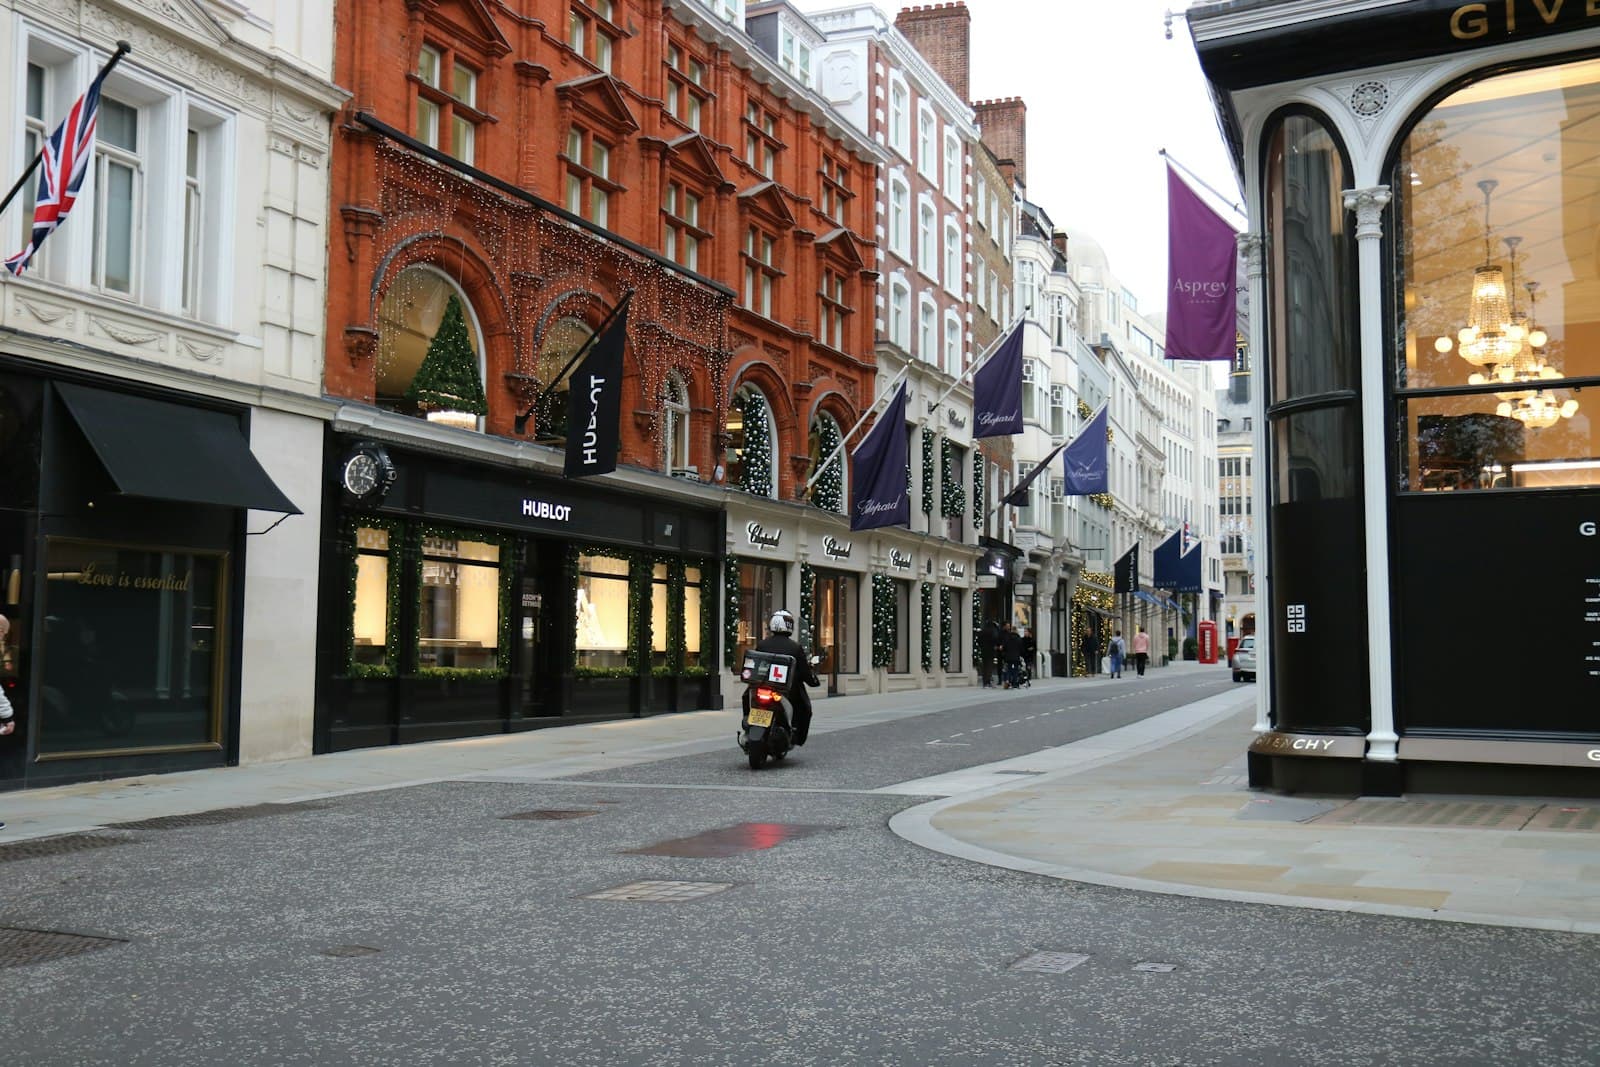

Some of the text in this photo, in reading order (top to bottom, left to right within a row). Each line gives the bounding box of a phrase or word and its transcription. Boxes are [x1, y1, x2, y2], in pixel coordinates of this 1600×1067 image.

[1450, 0, 1600, 39] GIV
[1174, 278, 1229, 297] Asprey
[583, 375, 605, 464] HUBOT
[977, 411, 1016, 427] Chopard
[523, 500, 571, 522] HUBLOT
[857, 495, 900, 516] Chopard
[746, 521, 782, 550] Chopard
[823, 535, 852, 561] Chopard
[79, 562, 191, 591] Love is essential
[773, 666, 783, 678] L
